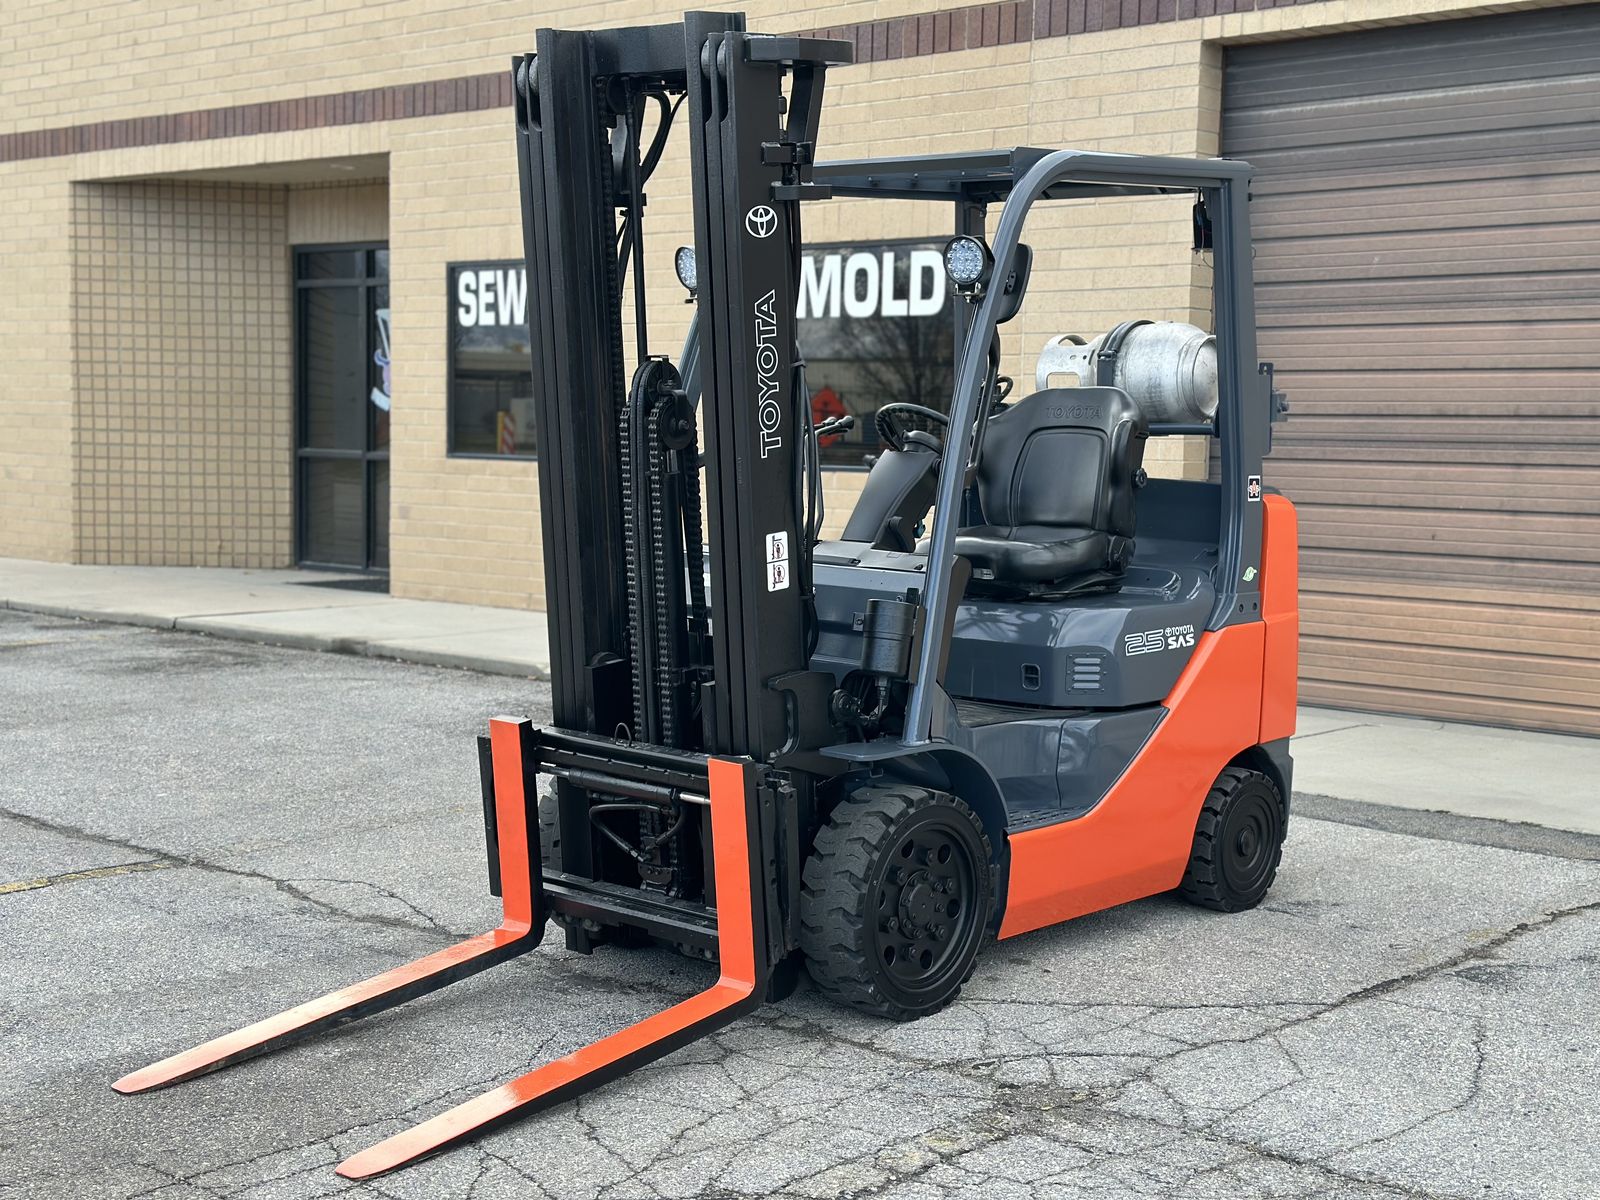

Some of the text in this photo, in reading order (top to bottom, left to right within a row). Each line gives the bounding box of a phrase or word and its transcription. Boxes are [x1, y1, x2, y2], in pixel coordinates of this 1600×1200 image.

[458, 269, 527, 327] SEW
[796, 250, 946, 319] MOLD
[754, 289, 783, 459] TOYOTA
[1046, 405, 1104, 419] TOYOTA
[1124, 629, 1165, 657] 25
[1167, 633, 1195, 650] SAS
[1171, 624, 1194, 636] TOYOTA
